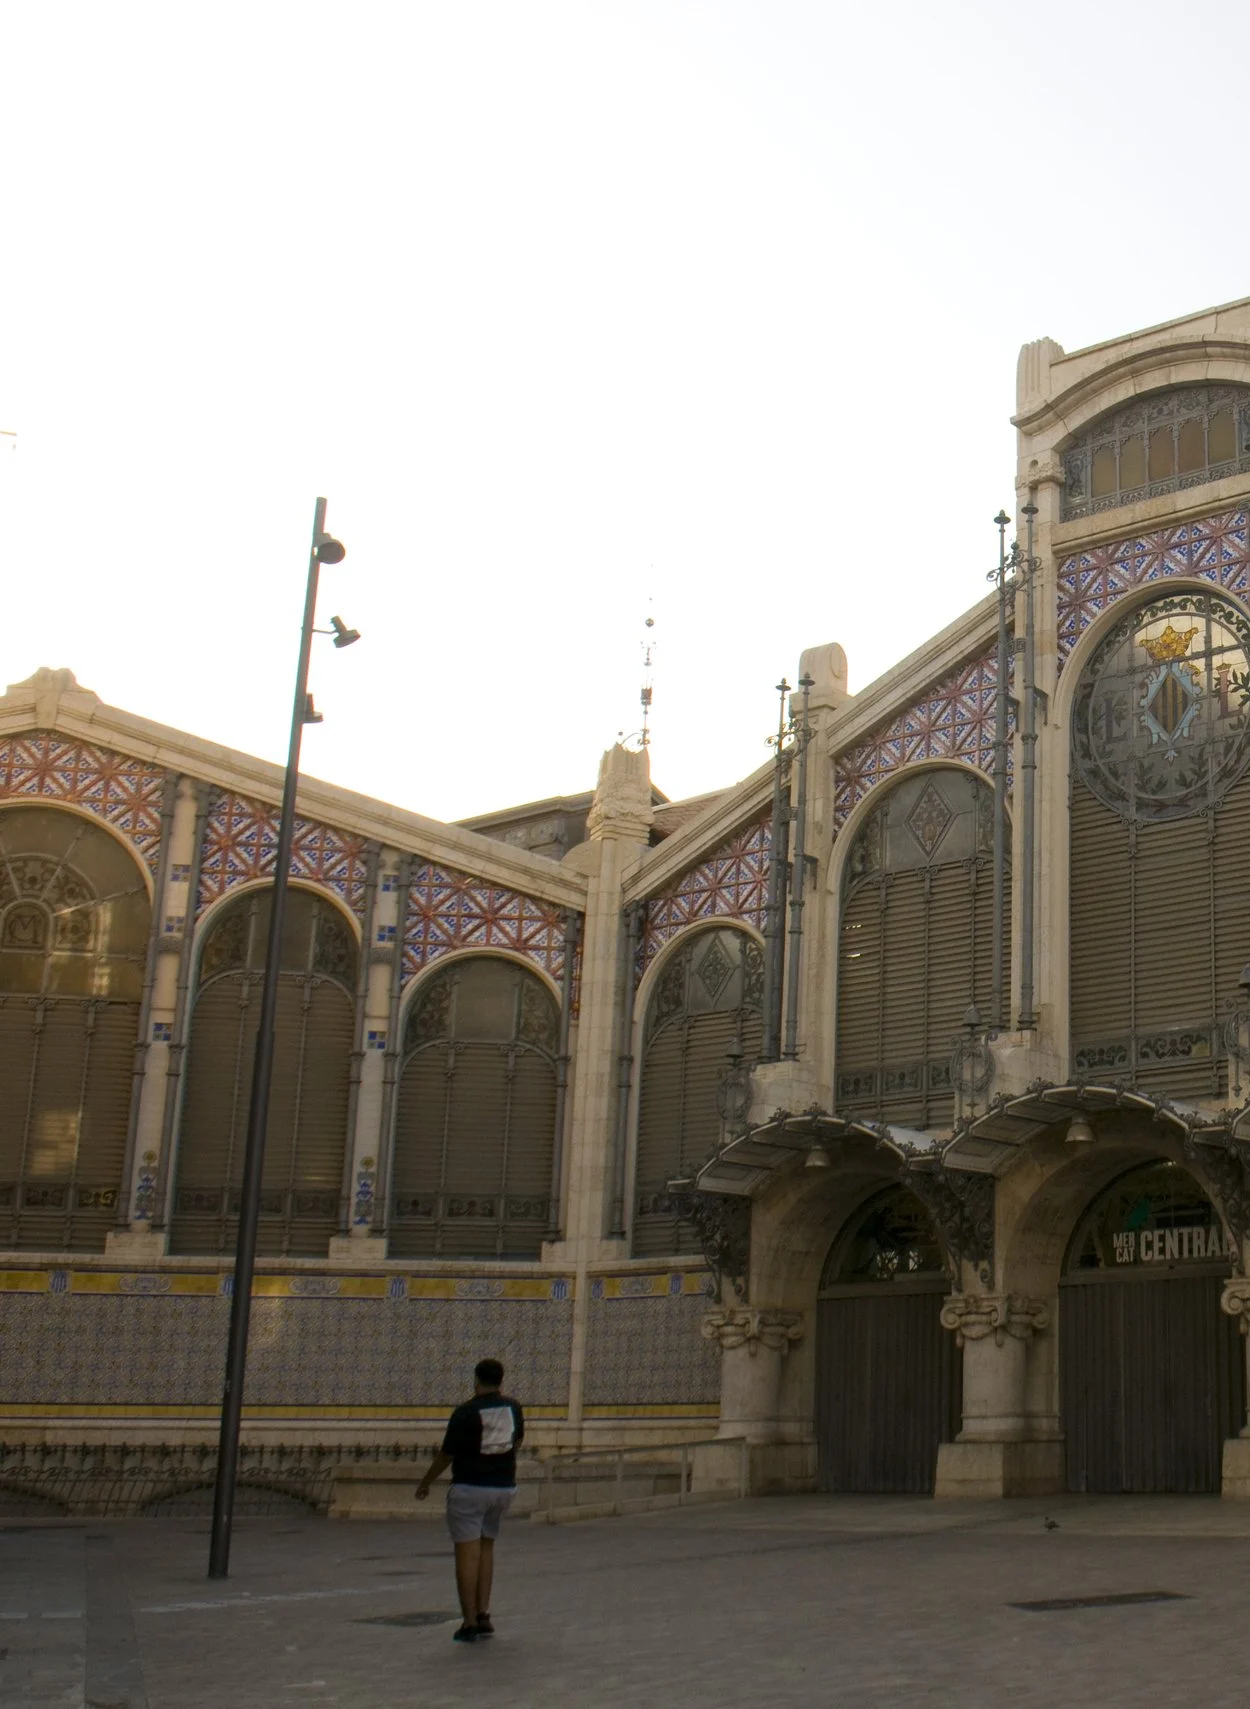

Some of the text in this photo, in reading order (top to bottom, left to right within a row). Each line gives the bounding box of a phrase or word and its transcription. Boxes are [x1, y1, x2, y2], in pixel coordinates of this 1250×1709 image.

[1219, 666, 1244, 721] L
[1113, 1232, 1135, 1248] MER
[1140, 1226, 1230, 1261] CENTRAL
[1116, 1248, 1134, 1263] CAT
